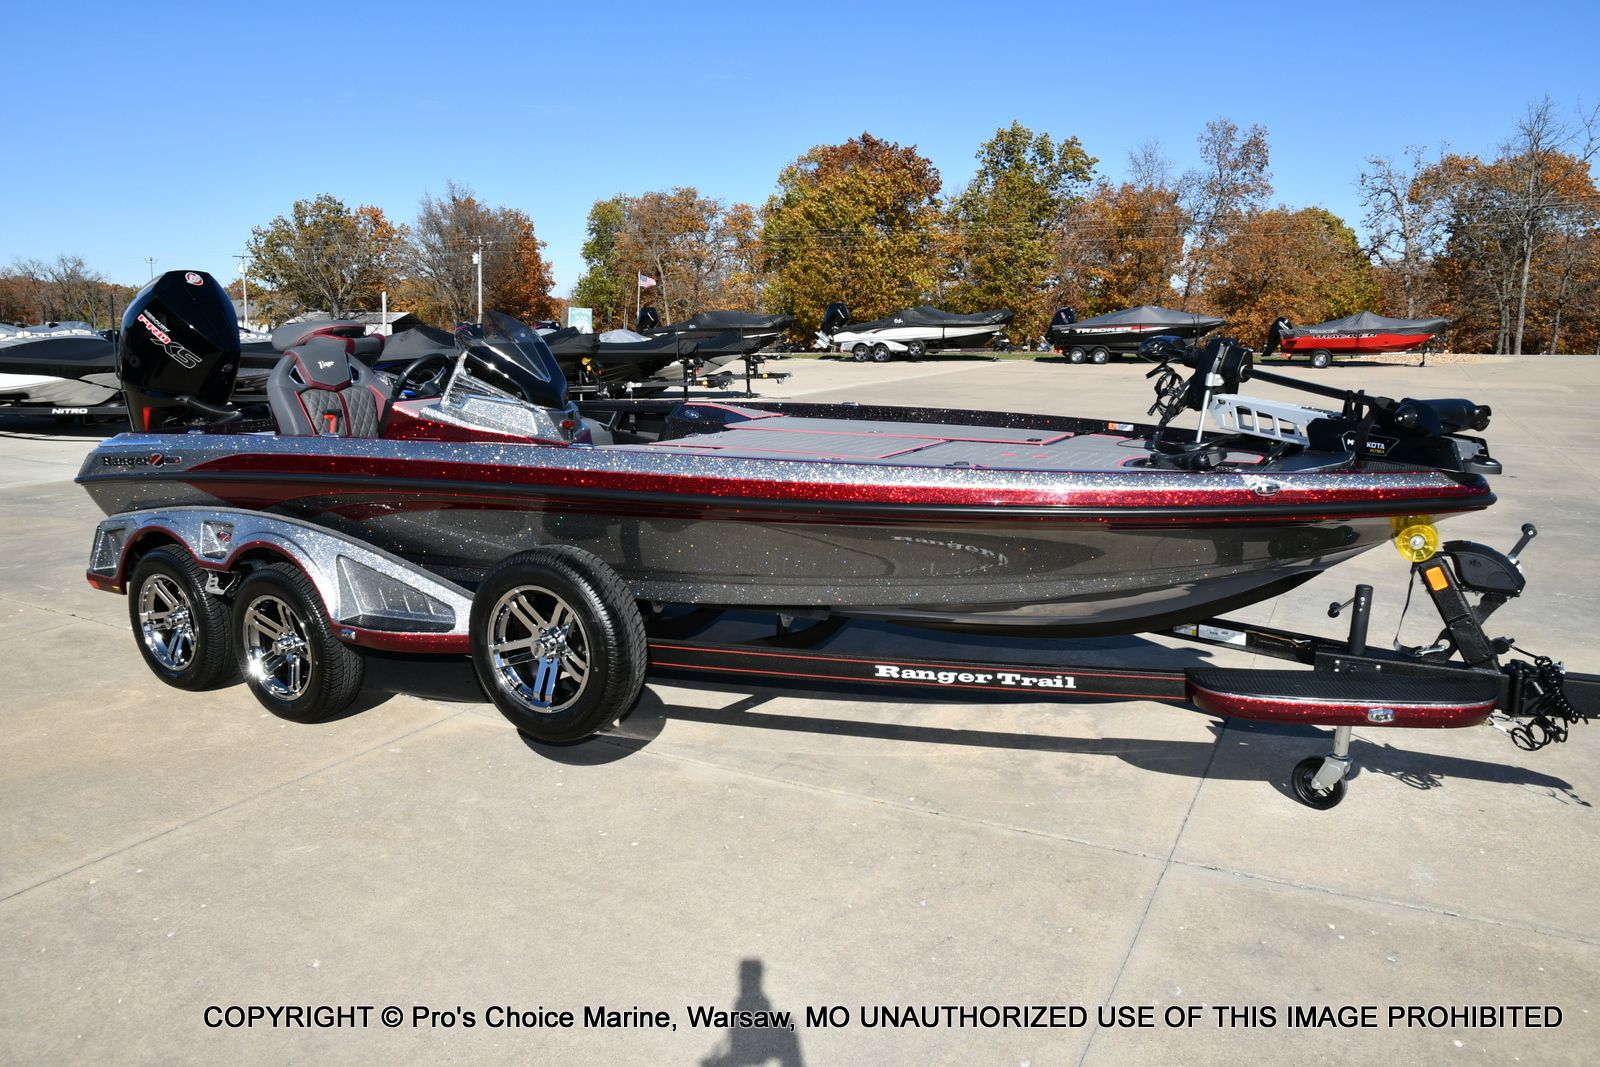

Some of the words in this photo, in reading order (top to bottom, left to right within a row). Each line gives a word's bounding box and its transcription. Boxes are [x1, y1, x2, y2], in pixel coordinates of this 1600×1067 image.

[137, 314, 171, 345] PRO
[144, 309, 170, 332] MERCURY
[150, 341, 202, 369] XS
[1366, 441, 1385, 450] KOTA
[102, 456, 150, 469] Ranger
[874, 664, 993, 684] Ranger
[997, 672, 1077, 689] Trail
